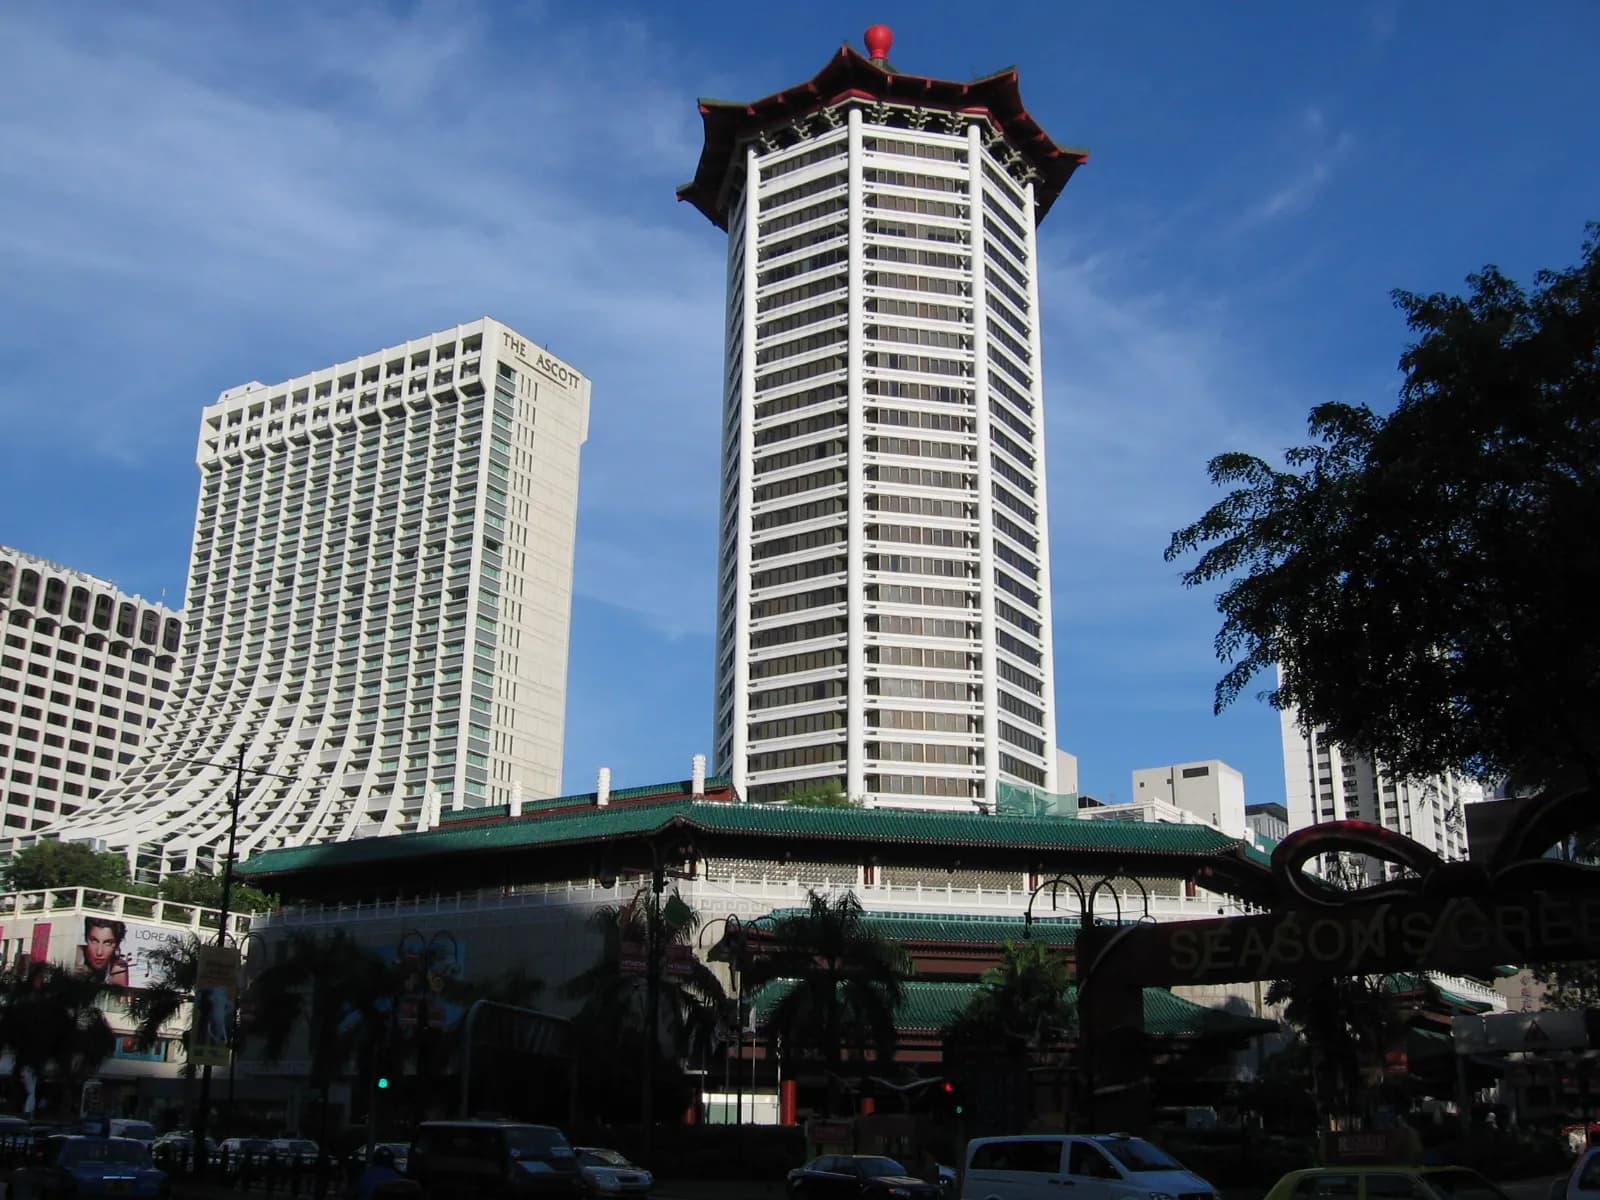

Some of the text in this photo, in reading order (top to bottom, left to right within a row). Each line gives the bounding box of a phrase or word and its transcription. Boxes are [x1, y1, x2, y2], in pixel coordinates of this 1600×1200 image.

[503, 332, 580, 389] THE ASCOTT
[1167, 908, 1434, 971] SEASON'S
